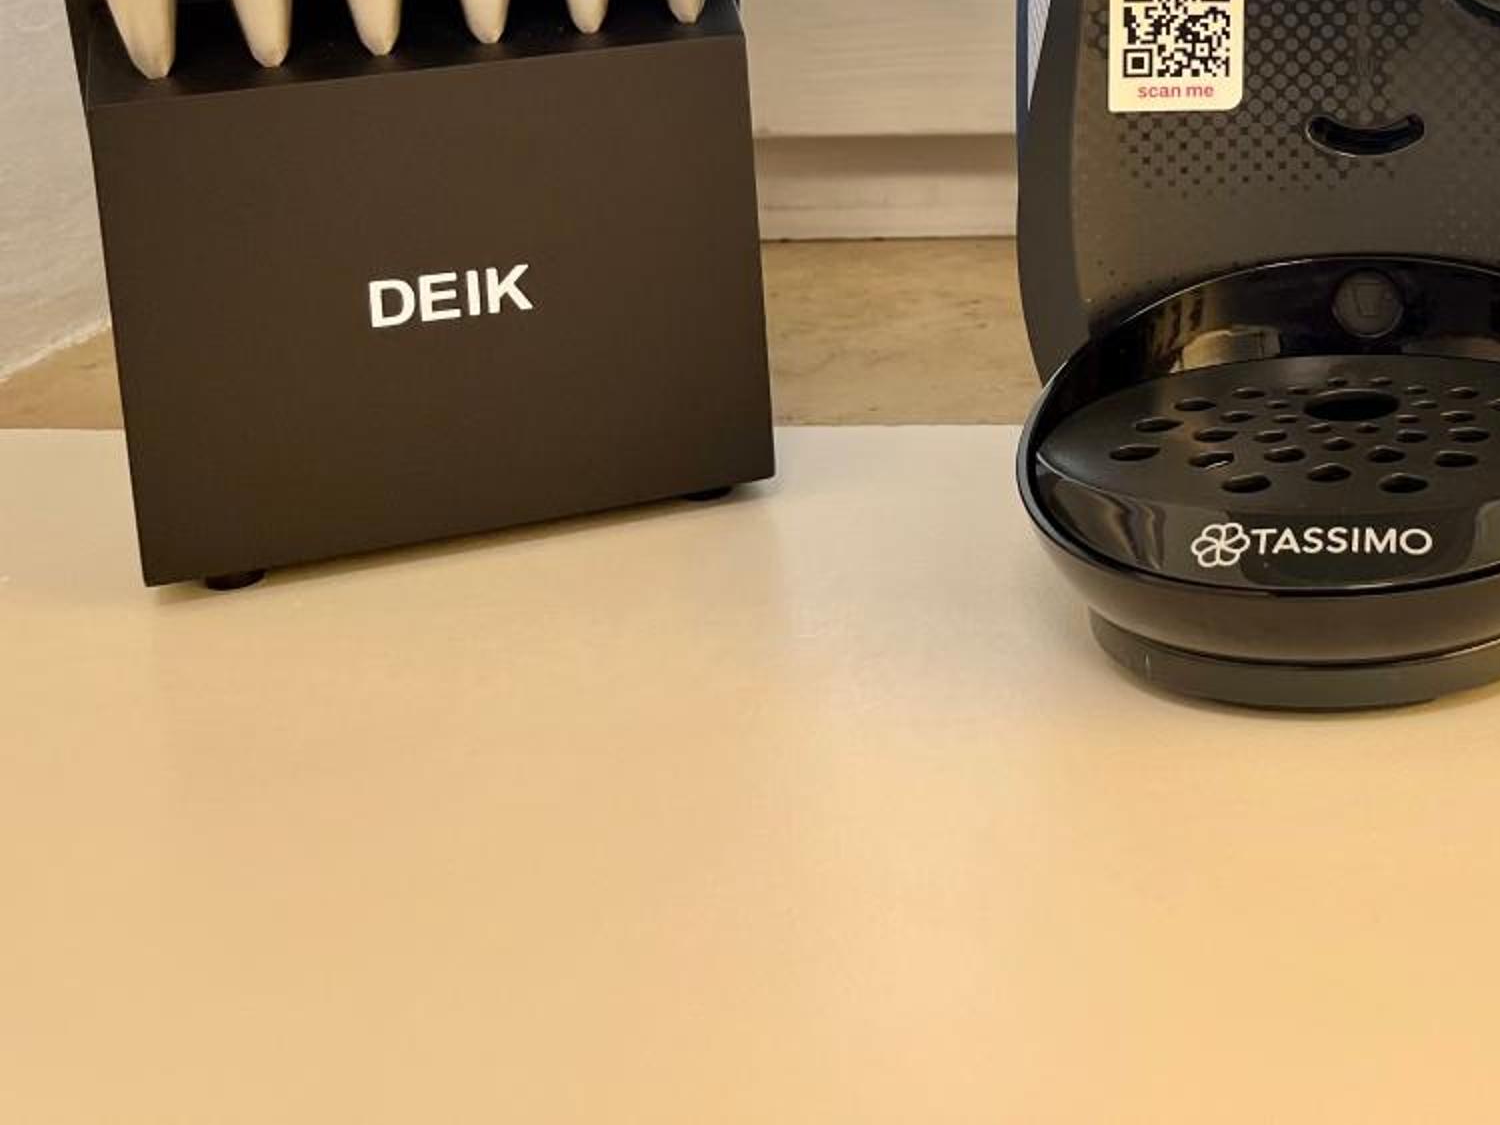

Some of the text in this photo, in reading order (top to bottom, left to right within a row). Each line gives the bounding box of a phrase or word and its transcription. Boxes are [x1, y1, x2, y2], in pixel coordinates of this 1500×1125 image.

[1138, 84, 1215, 98] scan me
[368, 264, 533, 328] DEIK
[1250, 527, 1433, 555] TASSIMO
